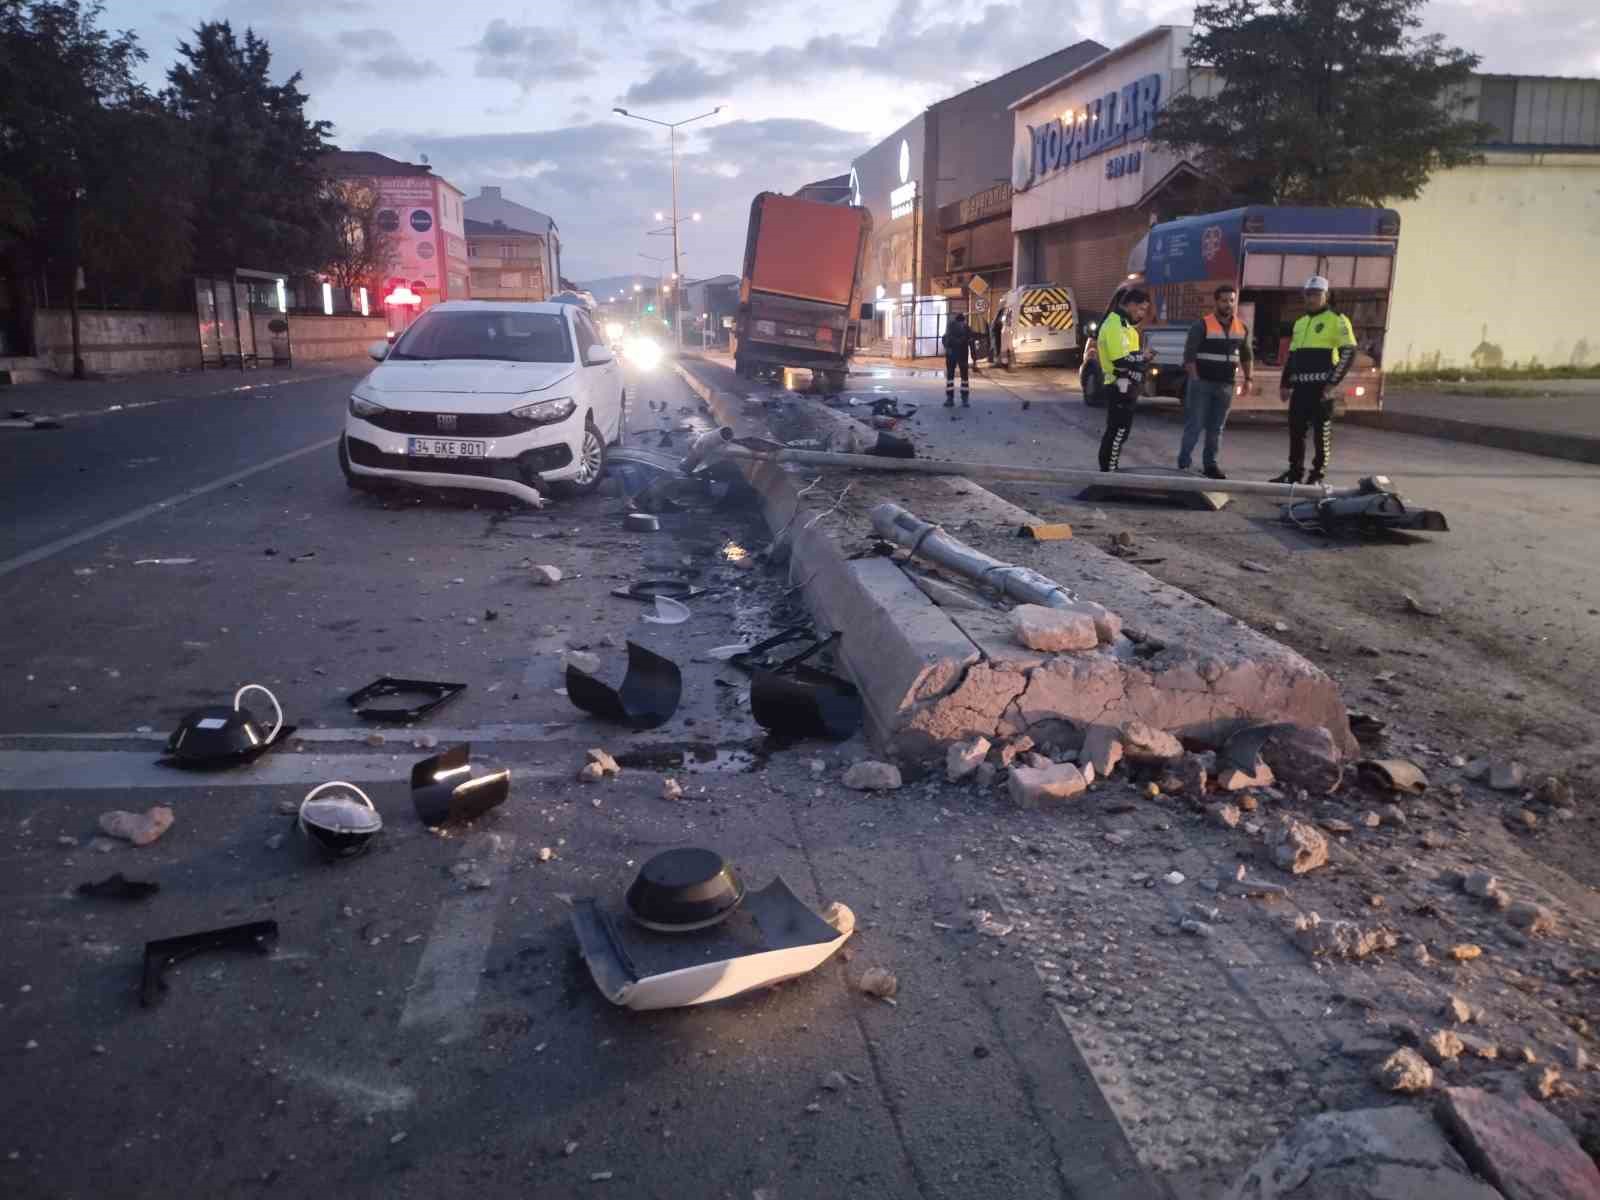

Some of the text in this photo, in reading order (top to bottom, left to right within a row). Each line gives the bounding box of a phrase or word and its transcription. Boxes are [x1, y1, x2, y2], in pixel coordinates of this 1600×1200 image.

[416, 440, 481, 455] 34 GKE 801
